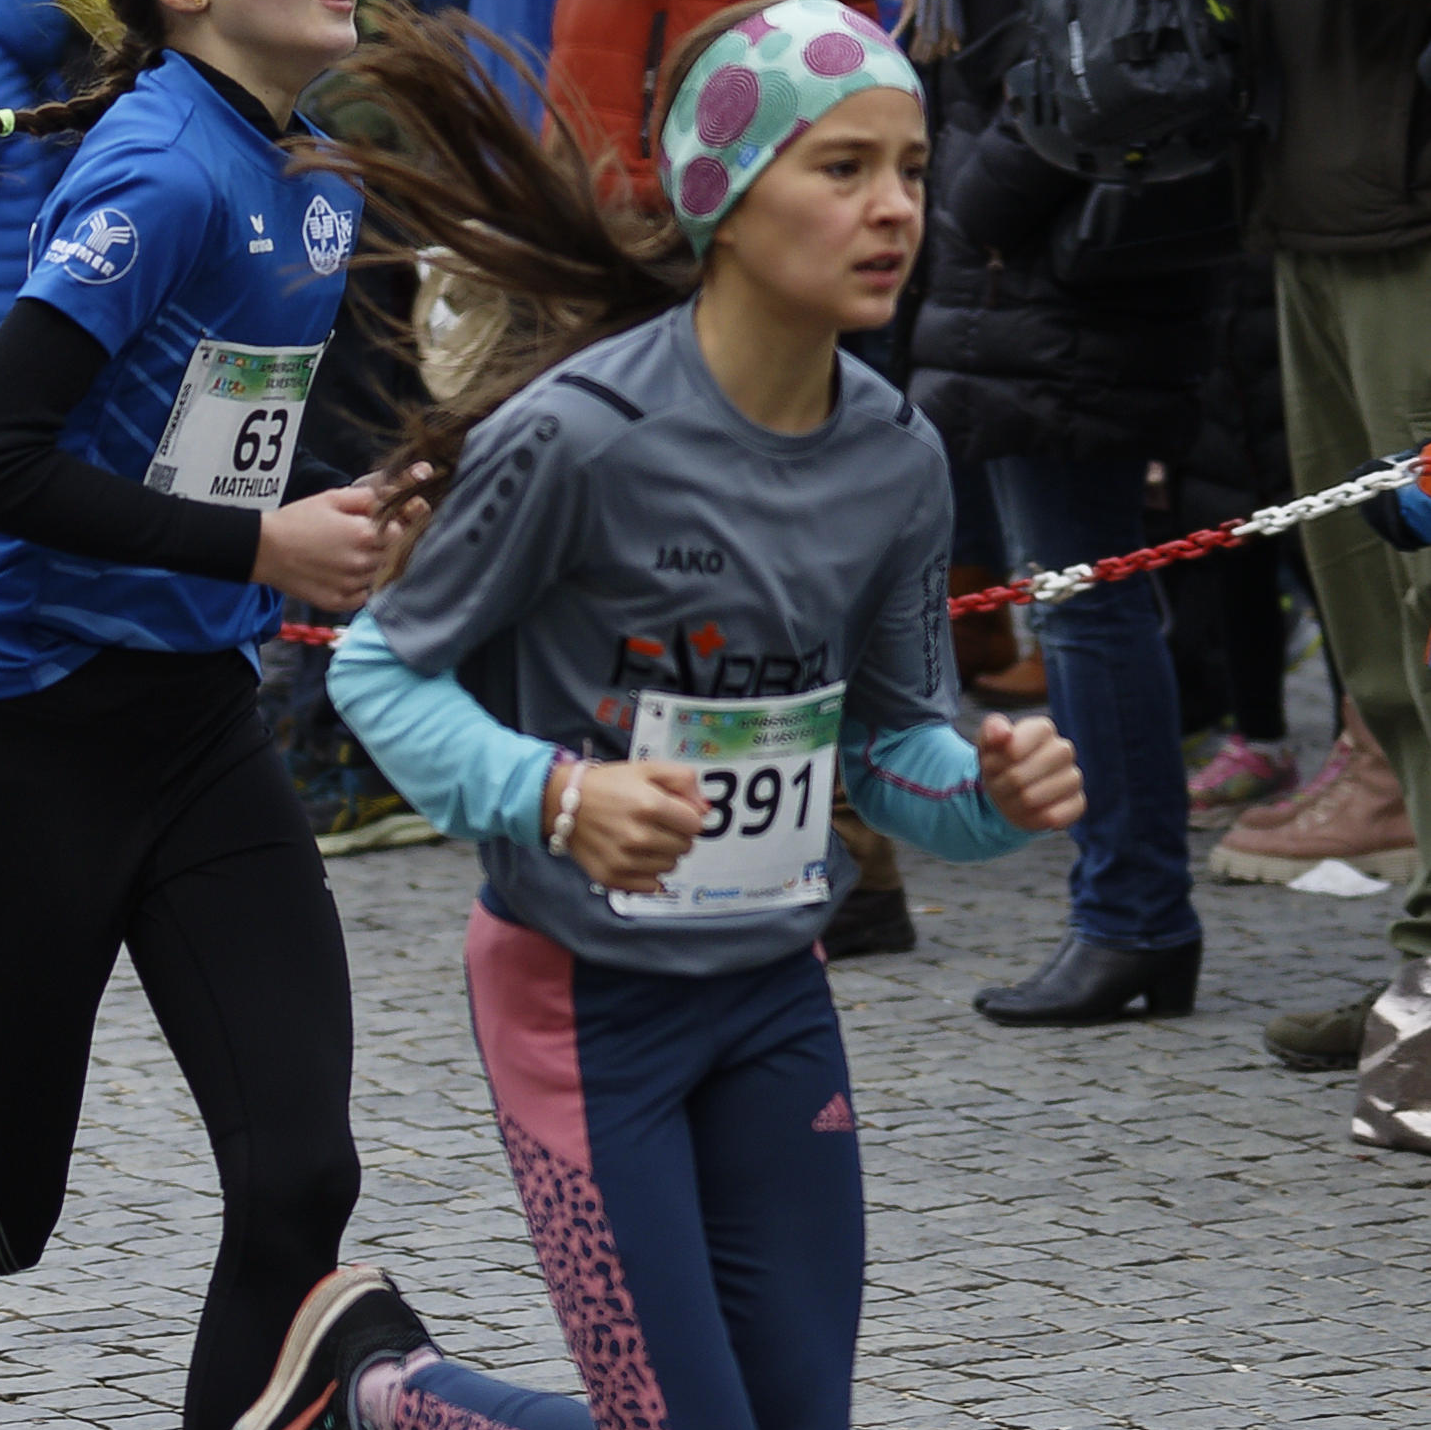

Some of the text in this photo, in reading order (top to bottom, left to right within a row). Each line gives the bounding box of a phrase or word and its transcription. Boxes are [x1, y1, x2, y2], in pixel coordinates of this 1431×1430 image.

[233, 408, 289, 472] 63
[210, 476, 281, 498] MATHILDA
[655, 545, 724, 576] JAKO
[696, 761, 813, 838] 391
